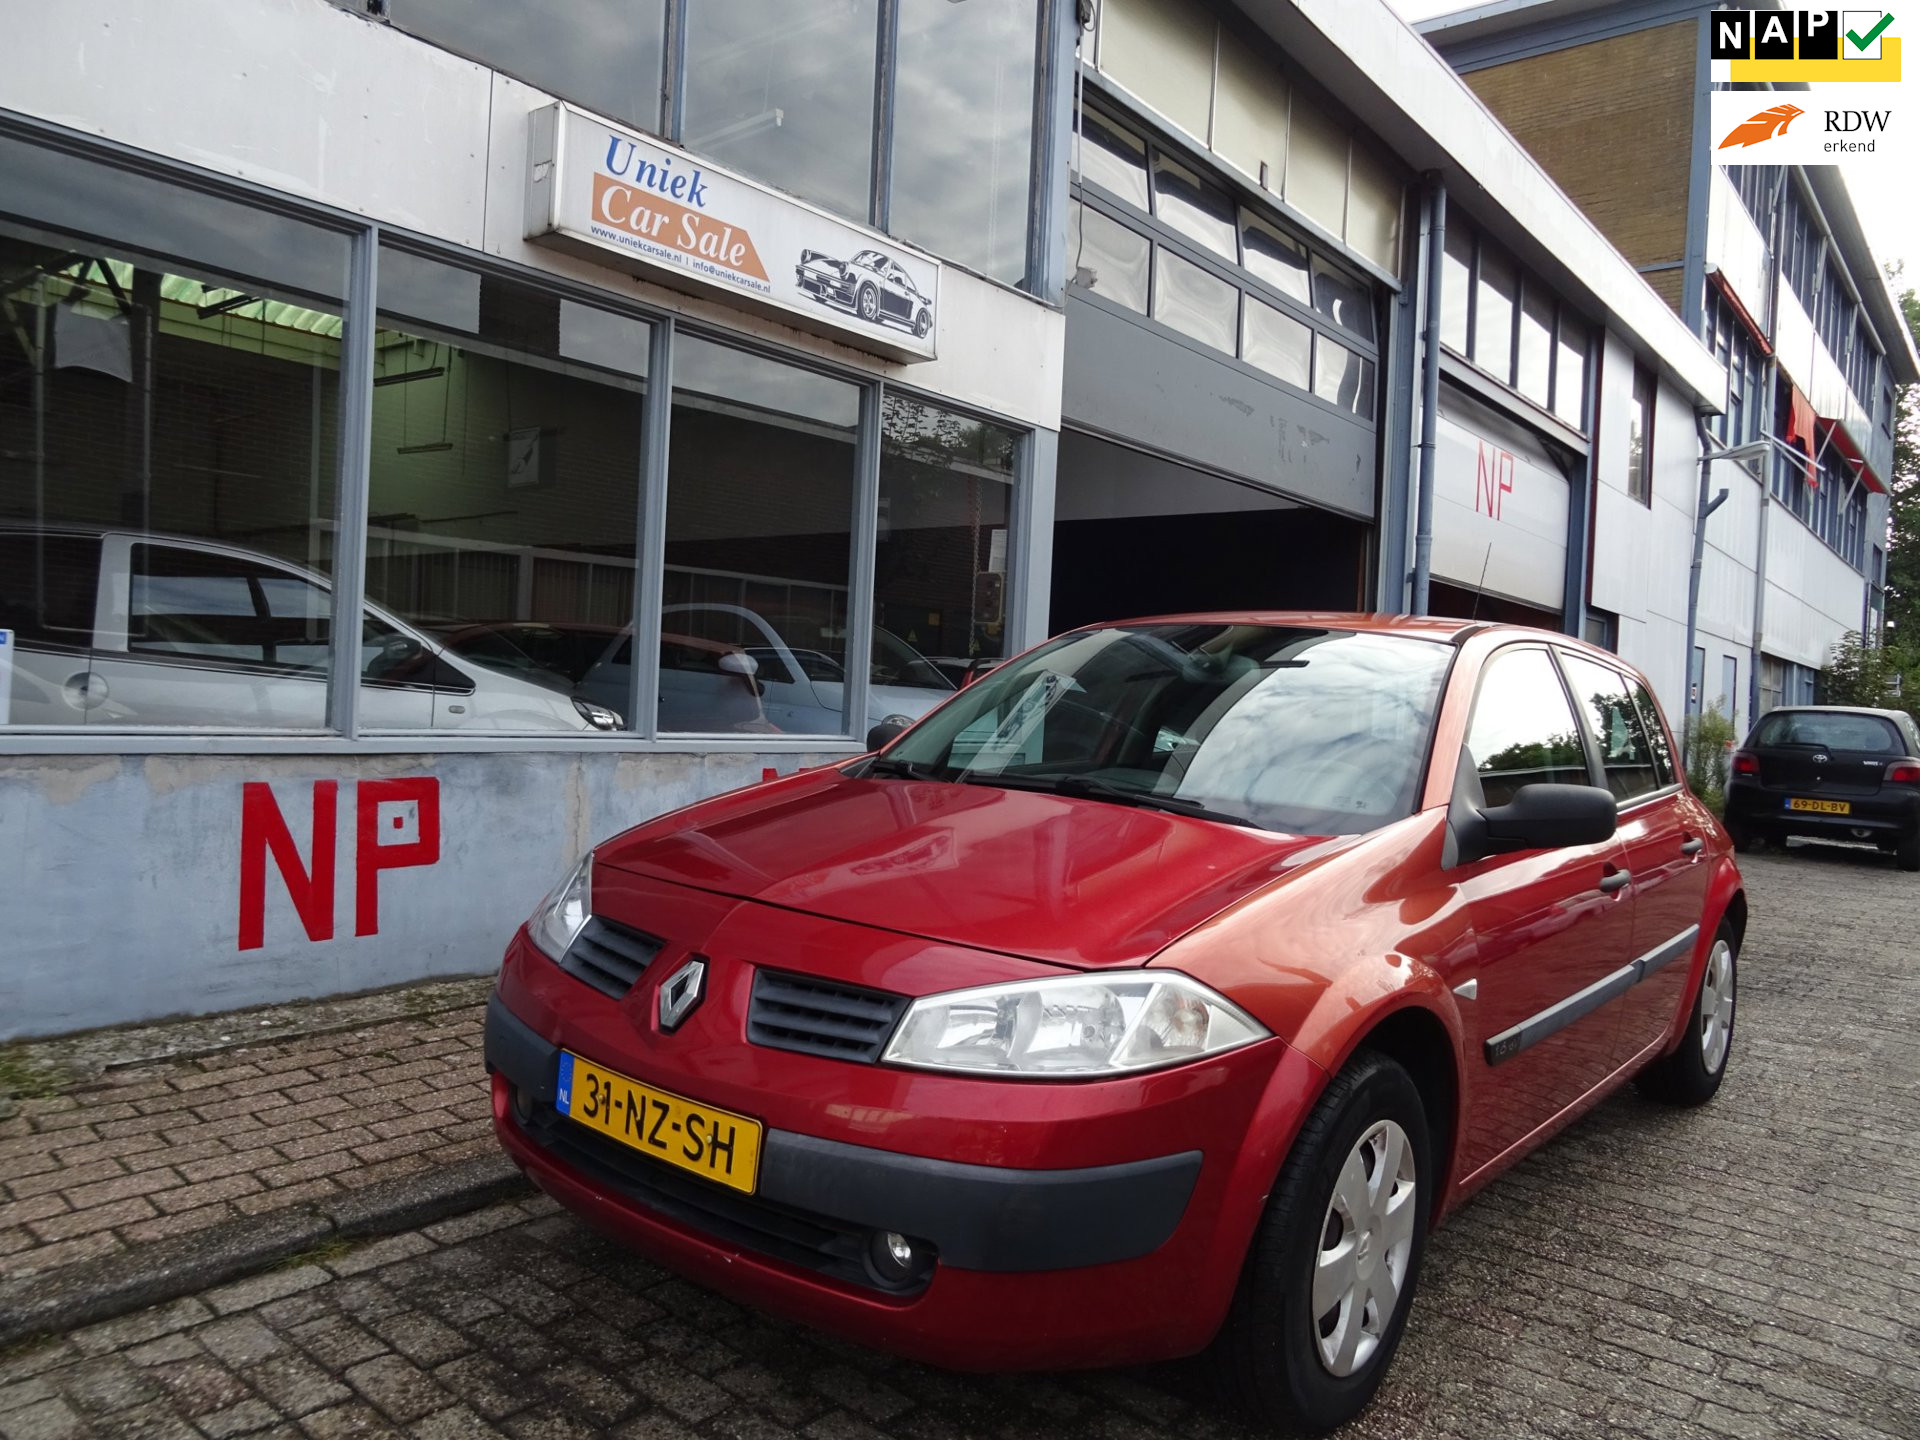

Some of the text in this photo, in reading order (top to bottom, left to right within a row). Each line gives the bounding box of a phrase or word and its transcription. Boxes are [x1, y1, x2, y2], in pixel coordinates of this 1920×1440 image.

[605, 134, 709, 208] Uniek
[590, 225, 682, 263] www.uniekcarsale.nl
[692, 260, 771, 294] info@uniekcarsale.nl
[601, 185, 746, 267] Car Sale
[1475, 439, 1514, 521] NP
[1793, 800, 1847, 812] 69-DL-BV
[238, 776, 440, 951] NP
[559, 1073, 736, 1175] NL 31-NZ-SH
